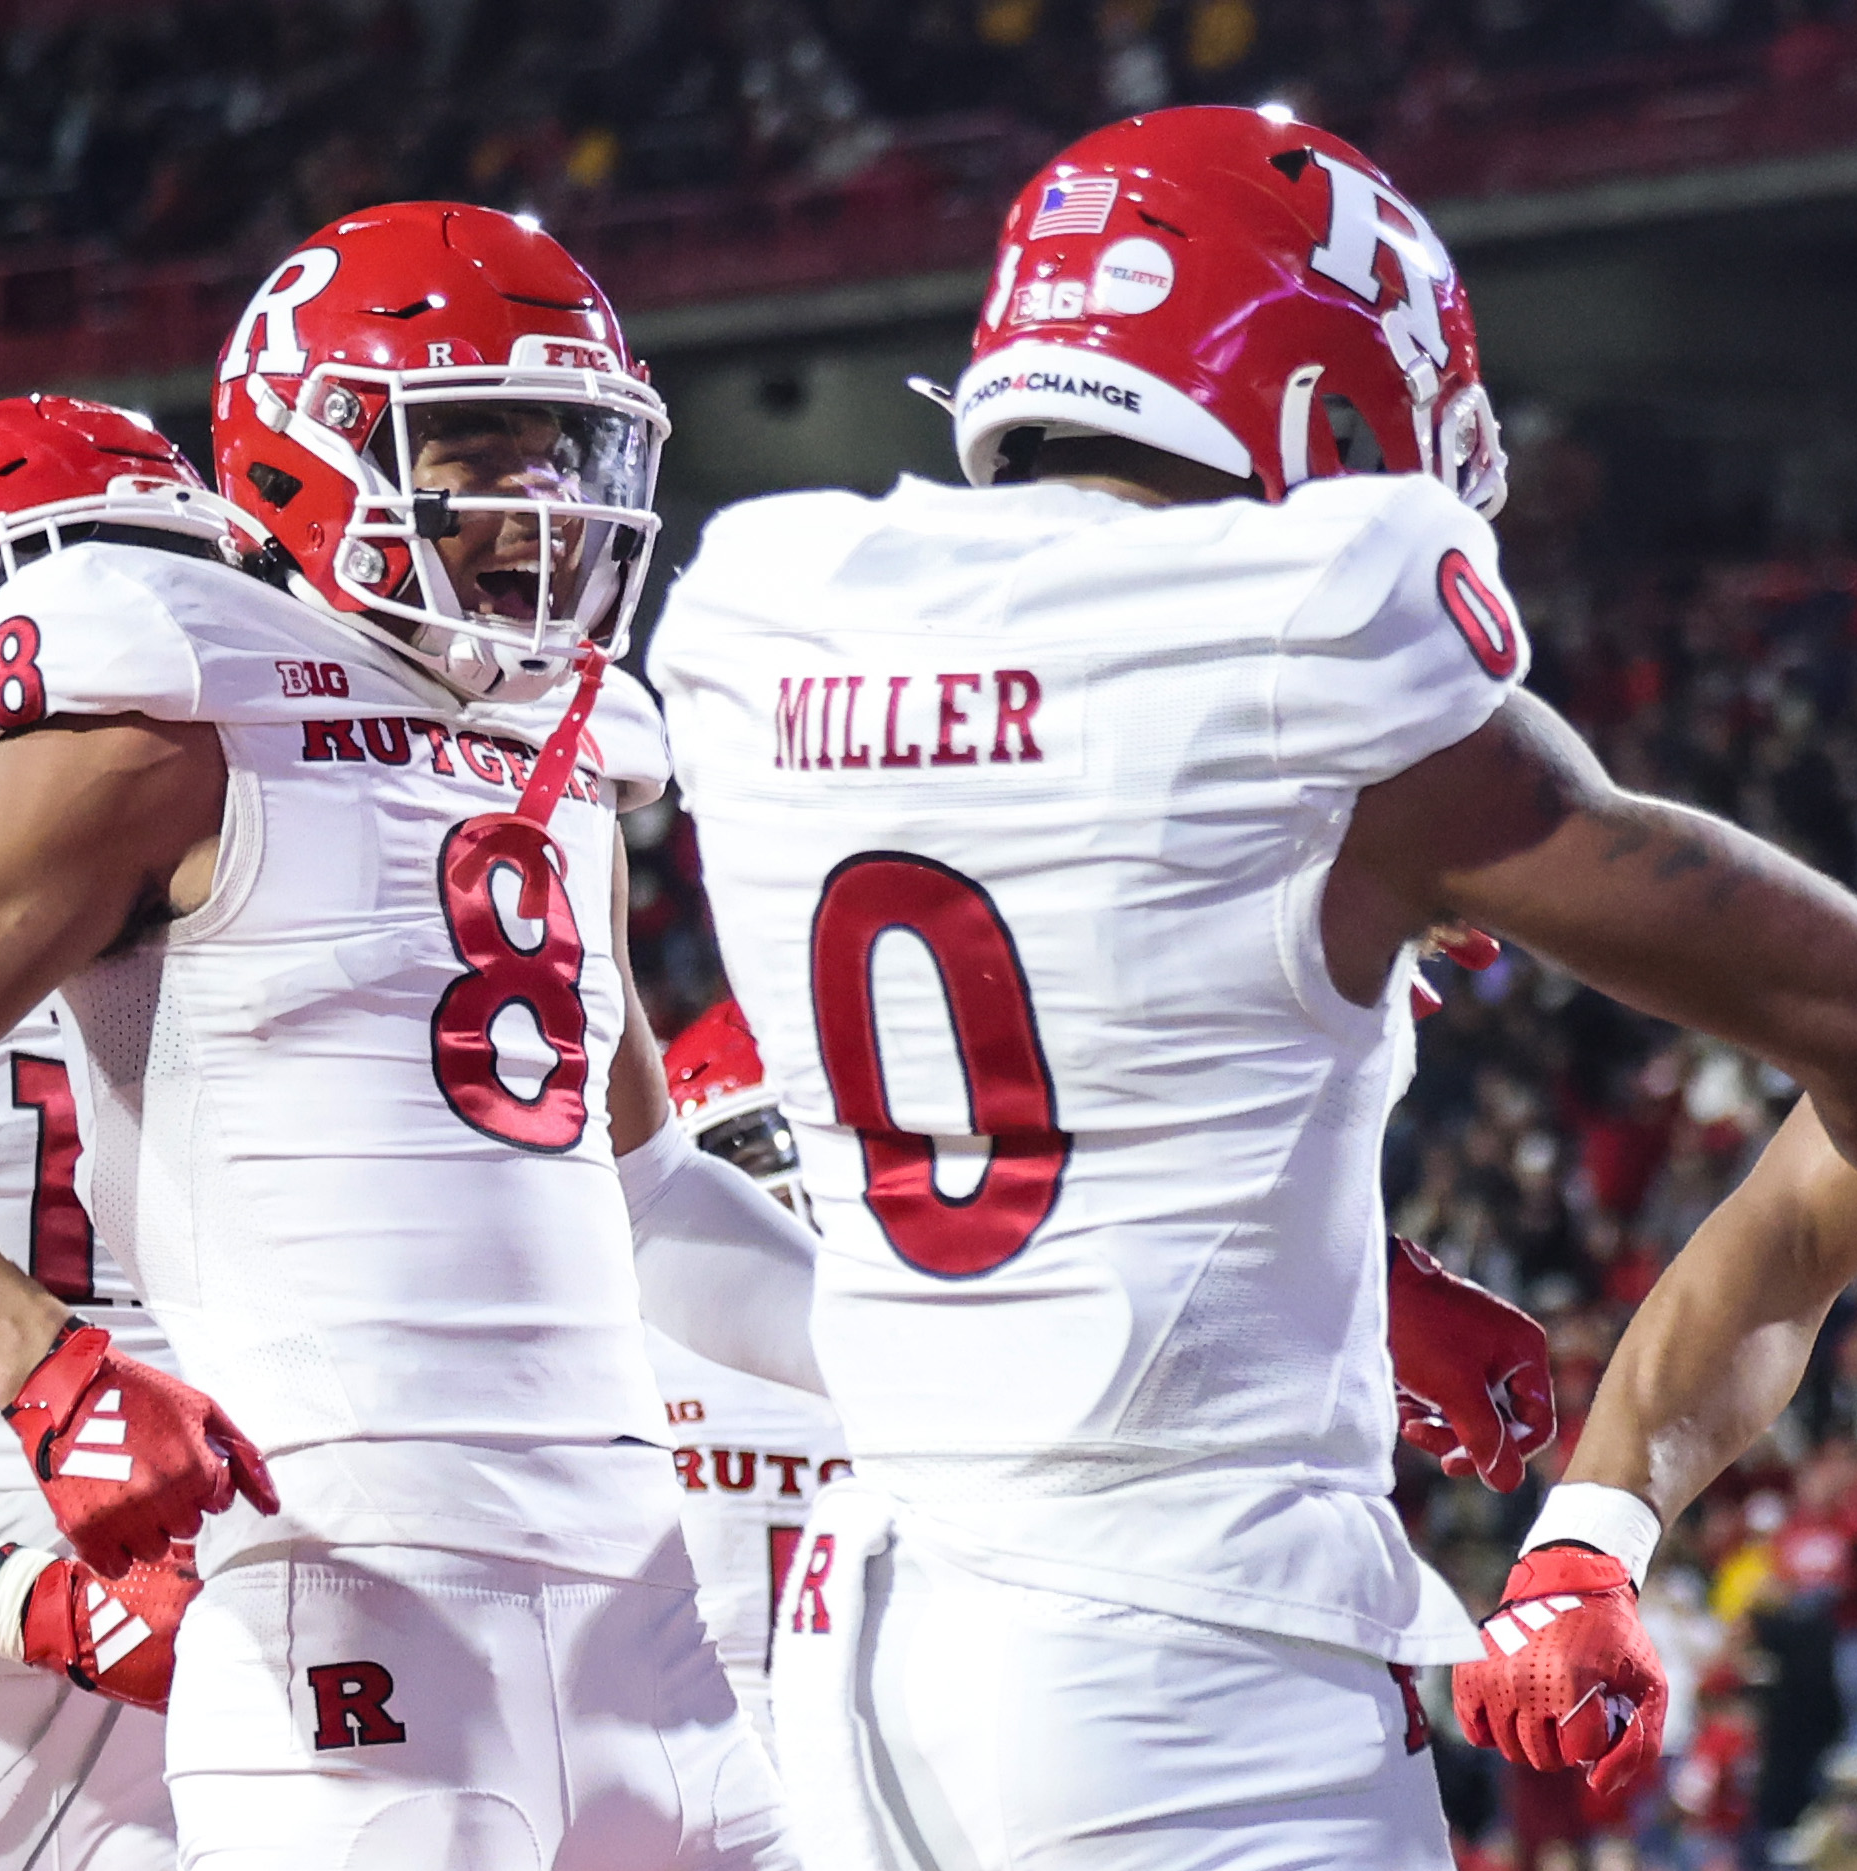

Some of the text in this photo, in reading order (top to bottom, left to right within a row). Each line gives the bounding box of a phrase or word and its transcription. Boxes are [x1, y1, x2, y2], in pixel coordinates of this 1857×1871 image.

[219, 246, 342, 384] R
[1309, 148, 1451, 376] R
[426, 342, 455, 368] R
[1436, 547, 1517, 681] 0
[774, 668, 1044, 771] MILLER
[430, 816, 589, 1155] 8
[809, 849, 1073, 1282] 0
[11, 1052, 143, 1306] 1
[793, 1532, 836, 1634] R
[307, 1660, 406, 1752] R
